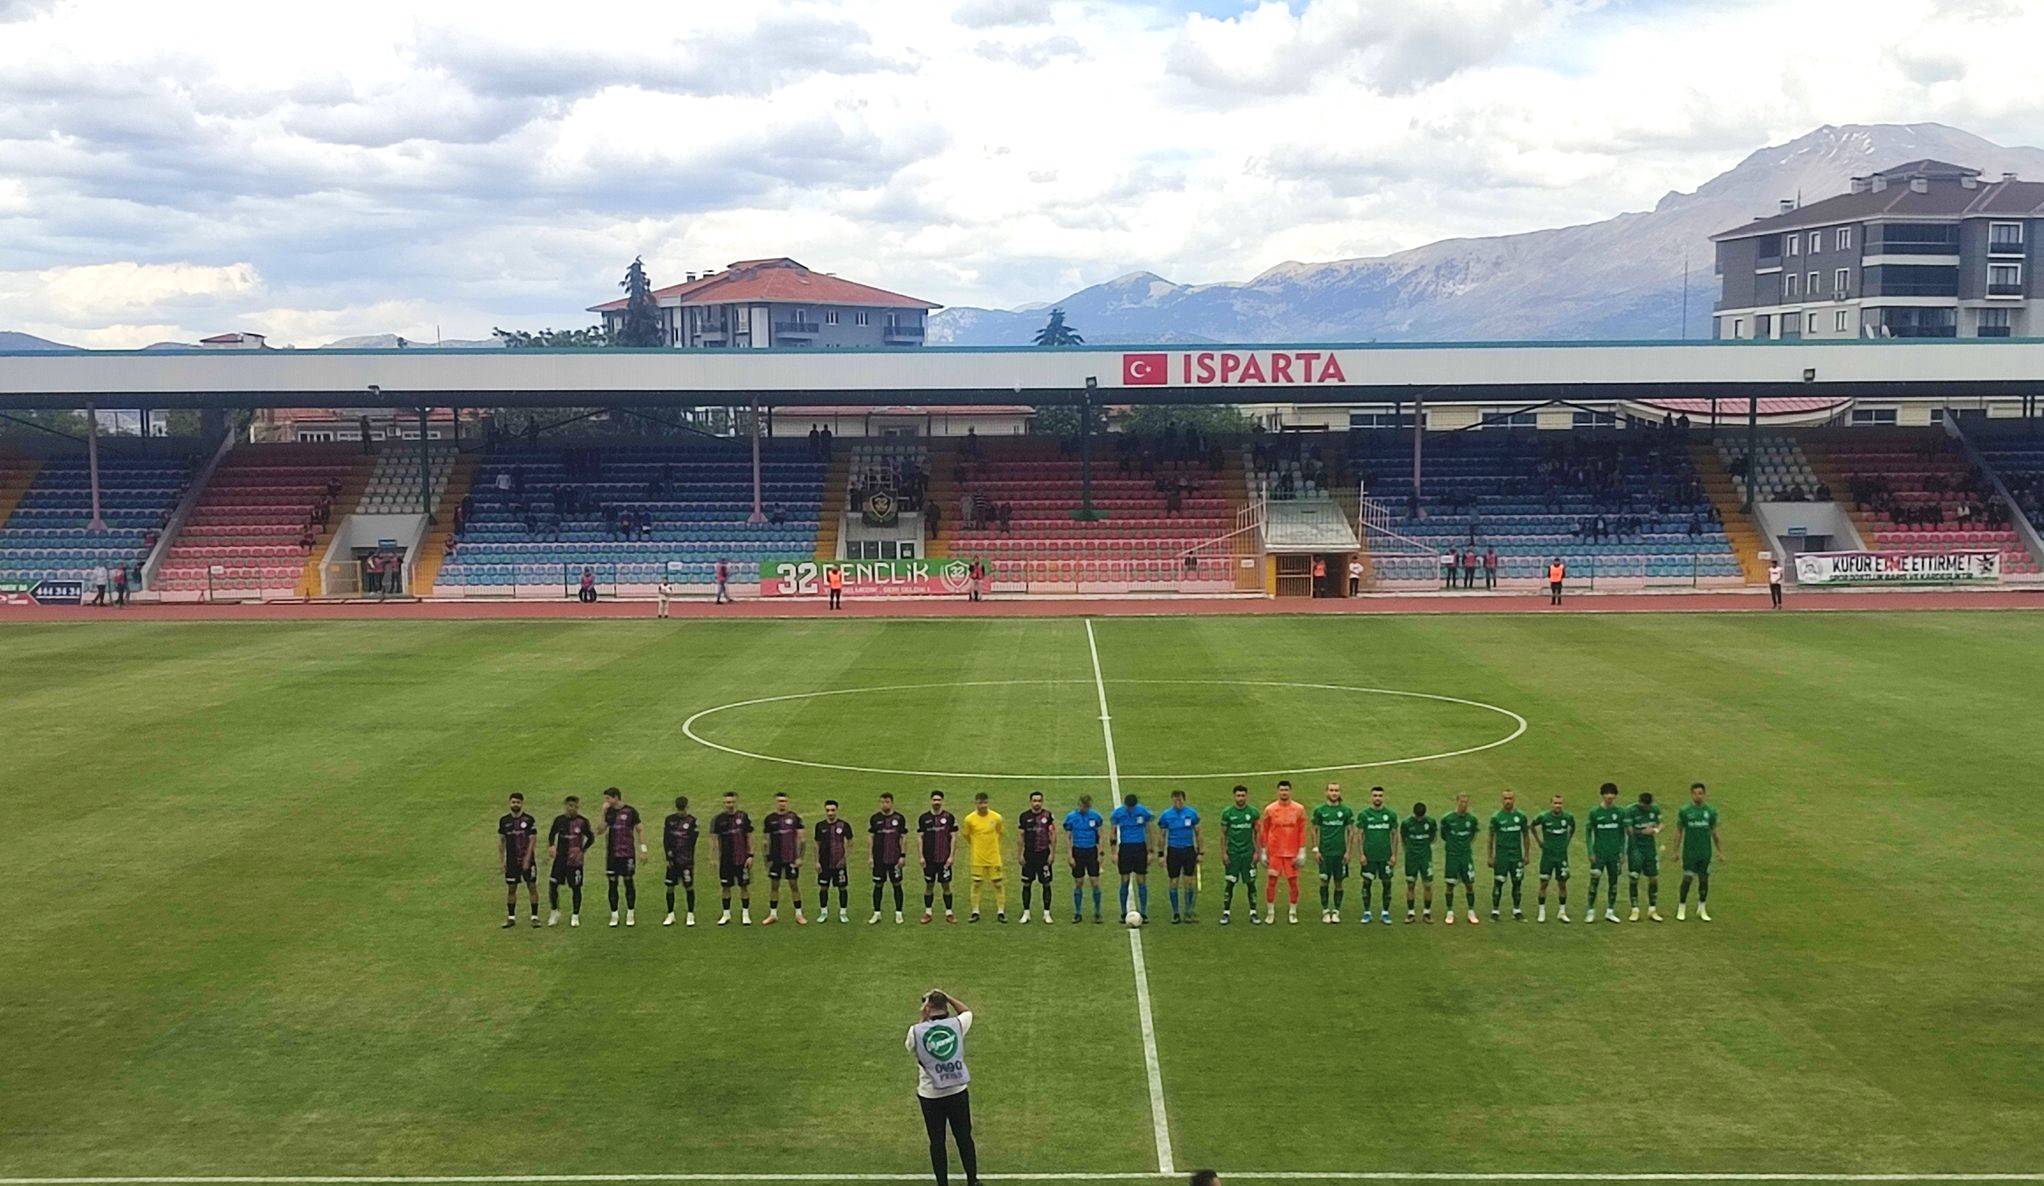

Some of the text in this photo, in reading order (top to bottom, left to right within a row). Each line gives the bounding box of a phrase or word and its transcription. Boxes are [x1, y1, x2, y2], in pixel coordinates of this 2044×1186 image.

[1183, 352, 1346, 384] ISPARTA
[777, 562, 818, 594] 32
[950, 566, 965, 579] 32
